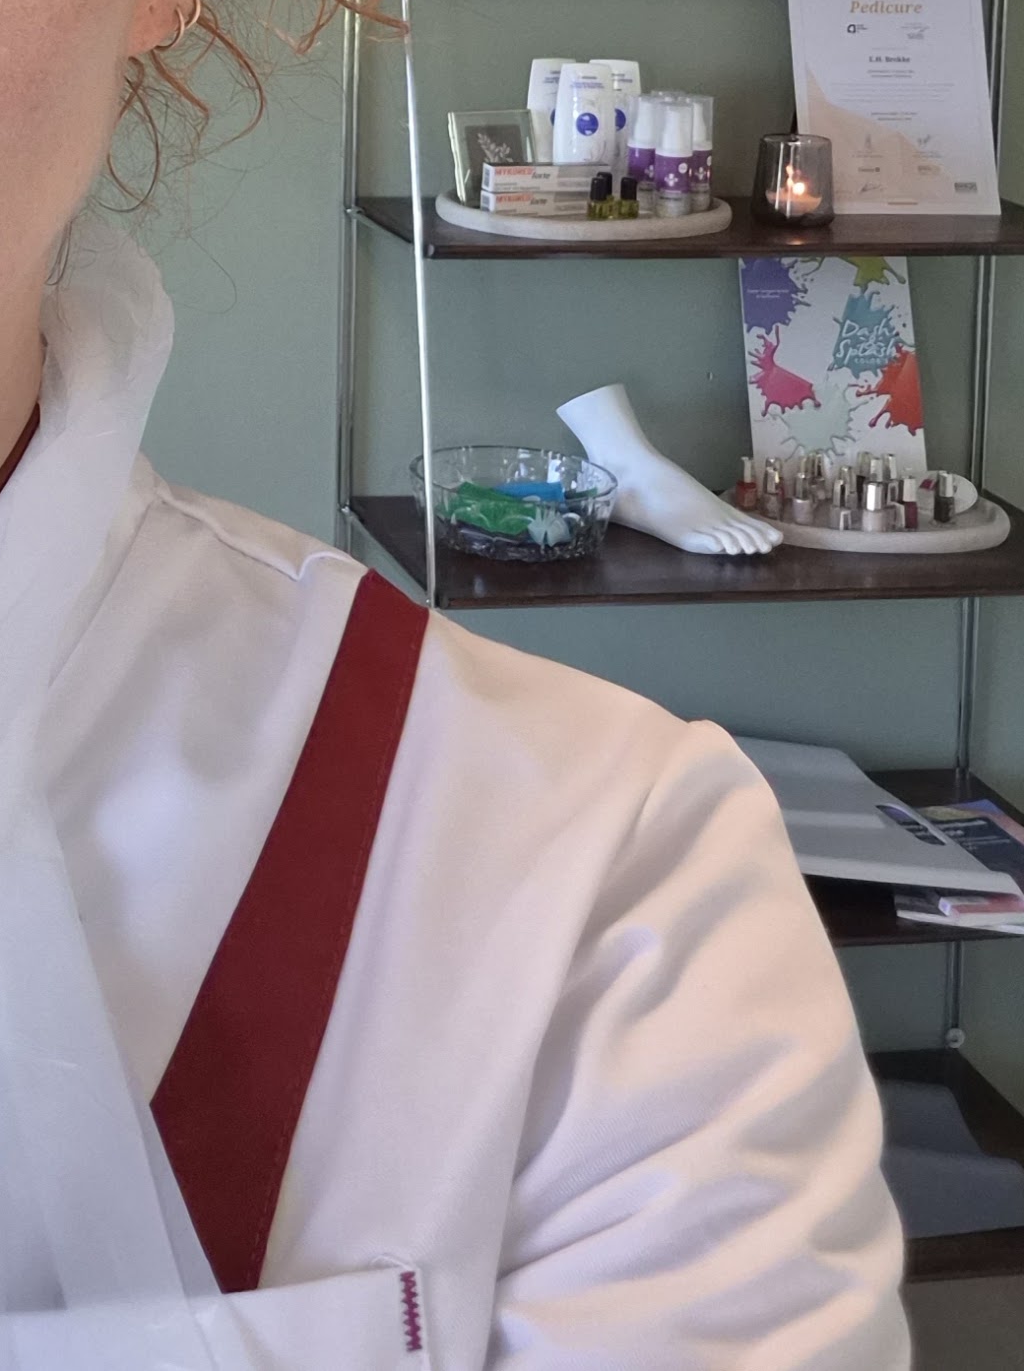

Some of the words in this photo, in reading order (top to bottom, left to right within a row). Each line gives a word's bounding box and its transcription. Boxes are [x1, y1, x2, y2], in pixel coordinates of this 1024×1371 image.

[849, 0, 923, 14] Pedicure
[842, 317, 890, 337] Dash
[836, 338, 895, 365] Splash
